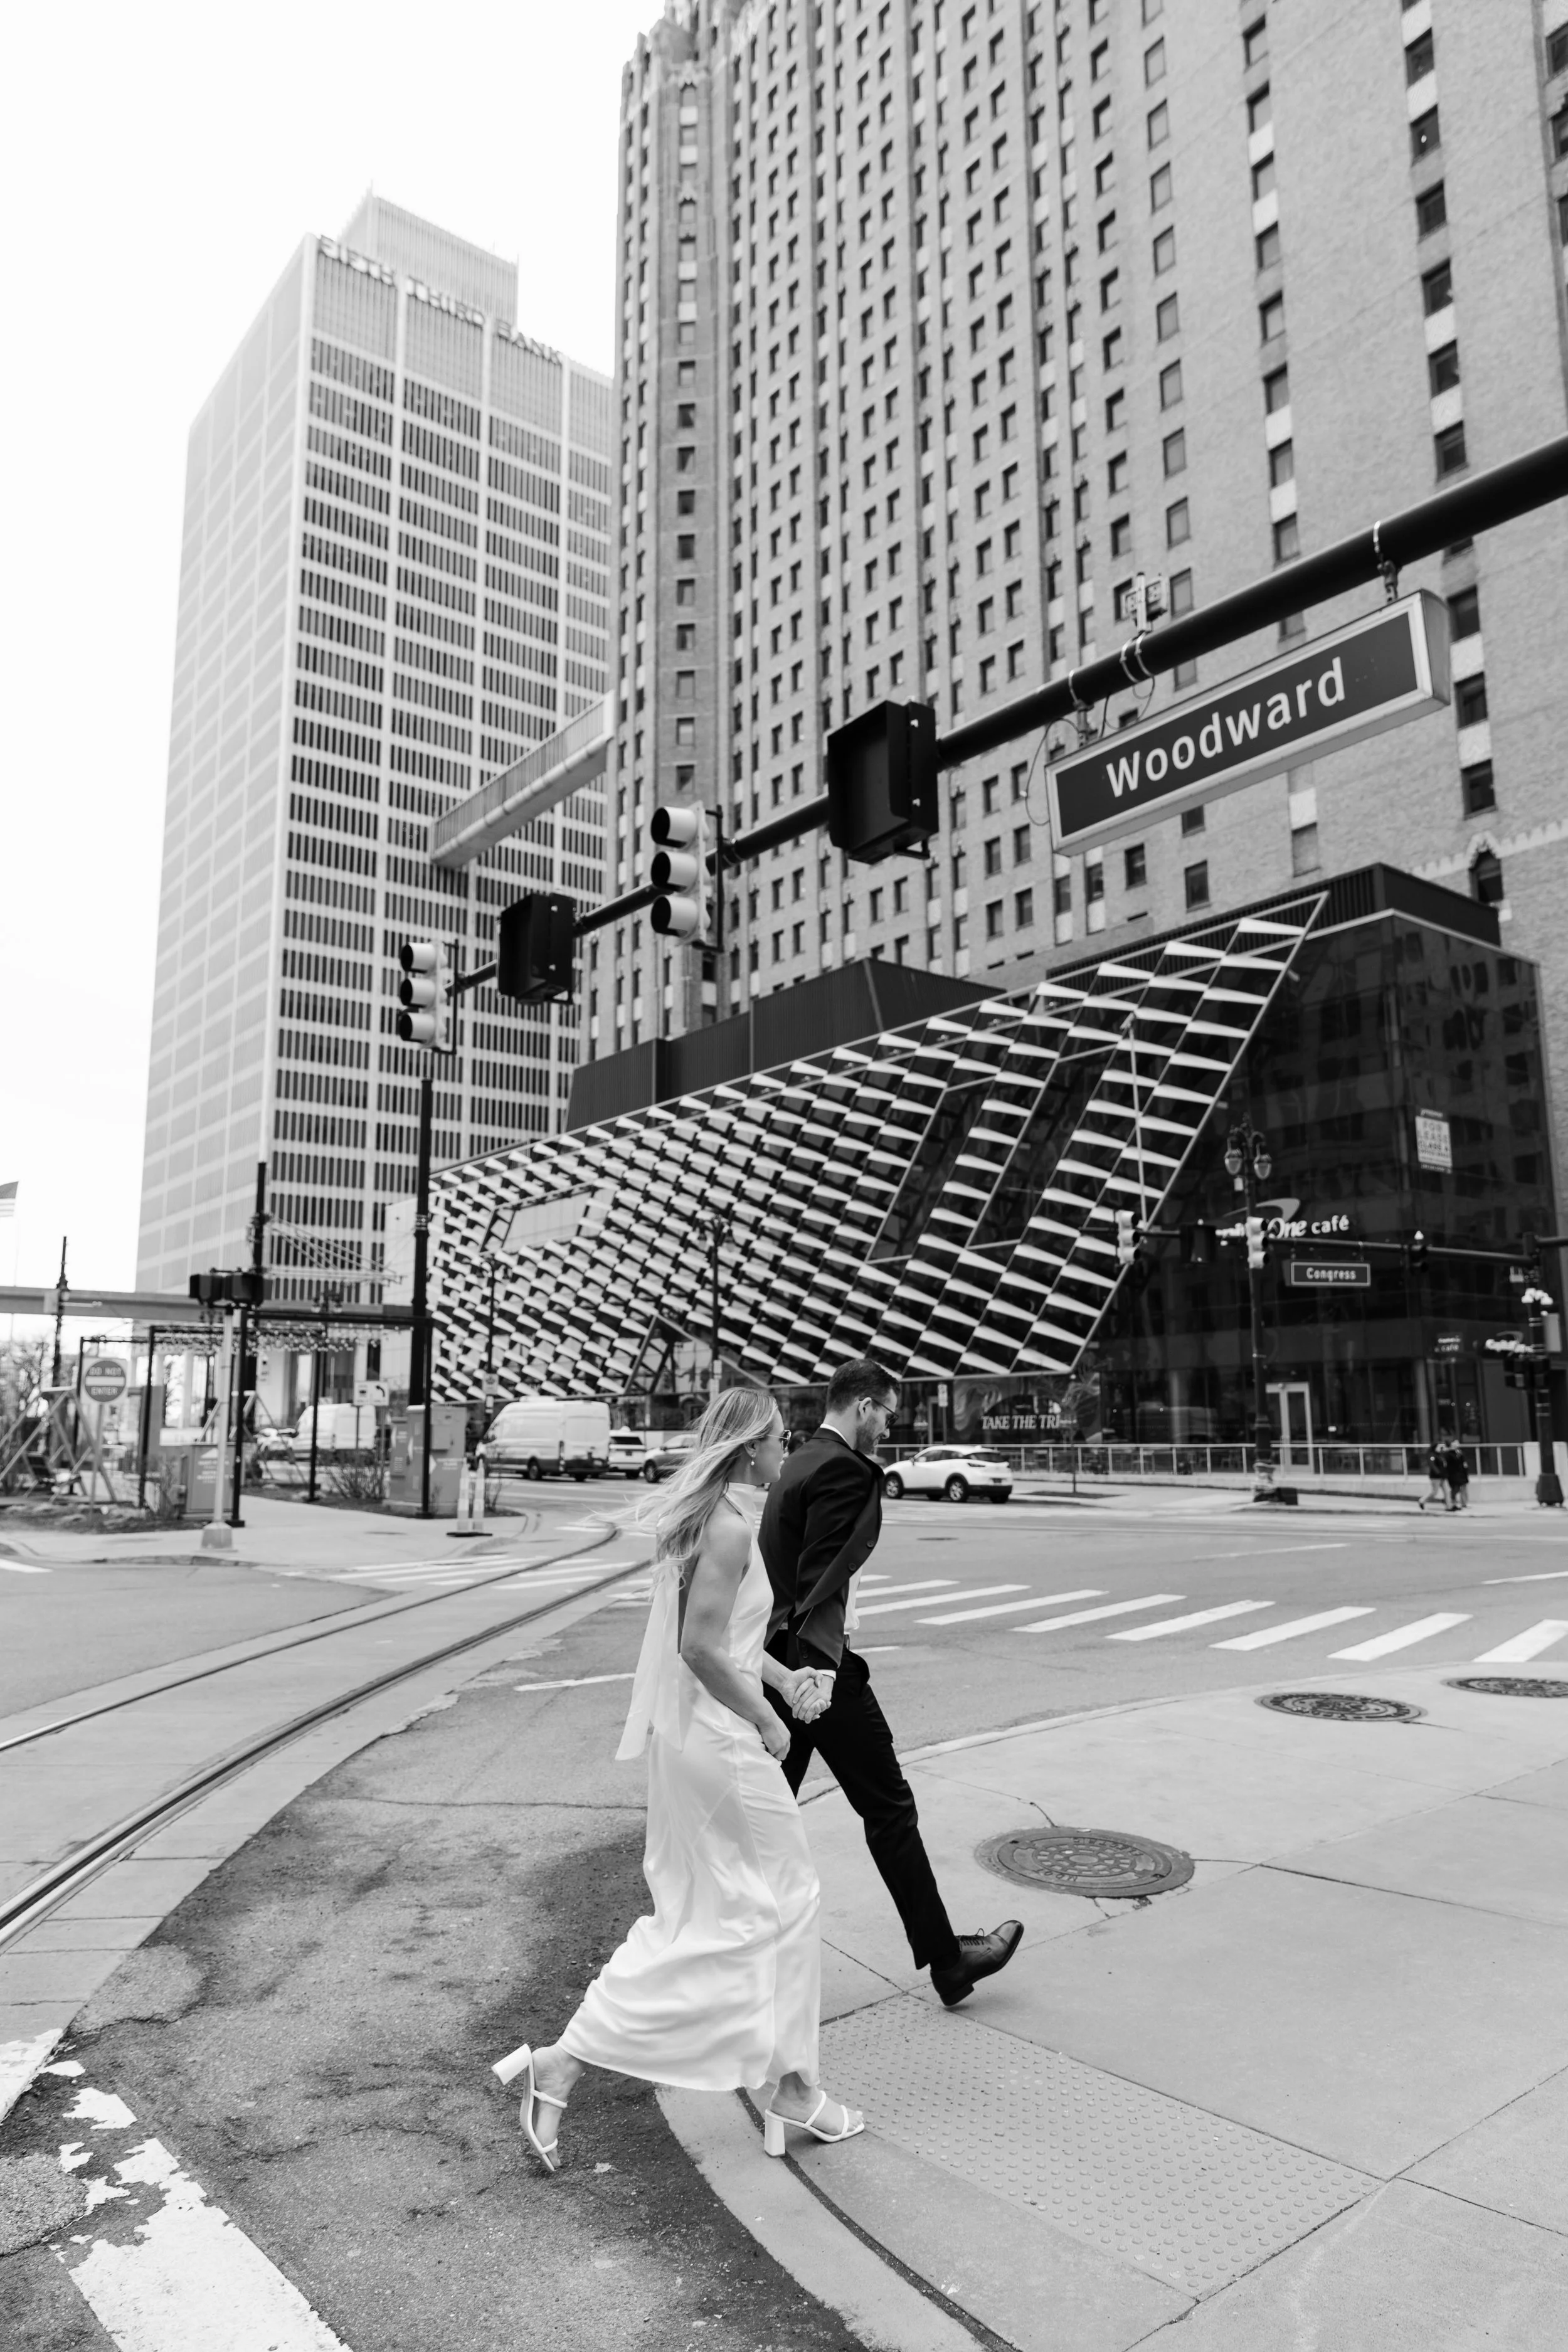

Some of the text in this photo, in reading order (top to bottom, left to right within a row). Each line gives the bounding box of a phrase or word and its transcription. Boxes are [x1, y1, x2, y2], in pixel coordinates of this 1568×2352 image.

[406, 274, 485, 331] THIRD
[494, 319, 563, 368] BANK
[1105, 656, 1346, 798] Woodward
[1268, 1217, 1308, 1239] One
[1311, 1214, 1350, 1234] café
[1306, 1267, 1357, 1283] Congress
[89, 1367, 122, 1376] DO NOT
[90, 1386, 118, 1396] ENTER
[982, 1415, 1010, 1430] TAKE
[1012, 1414, 1037, 1430] THE
